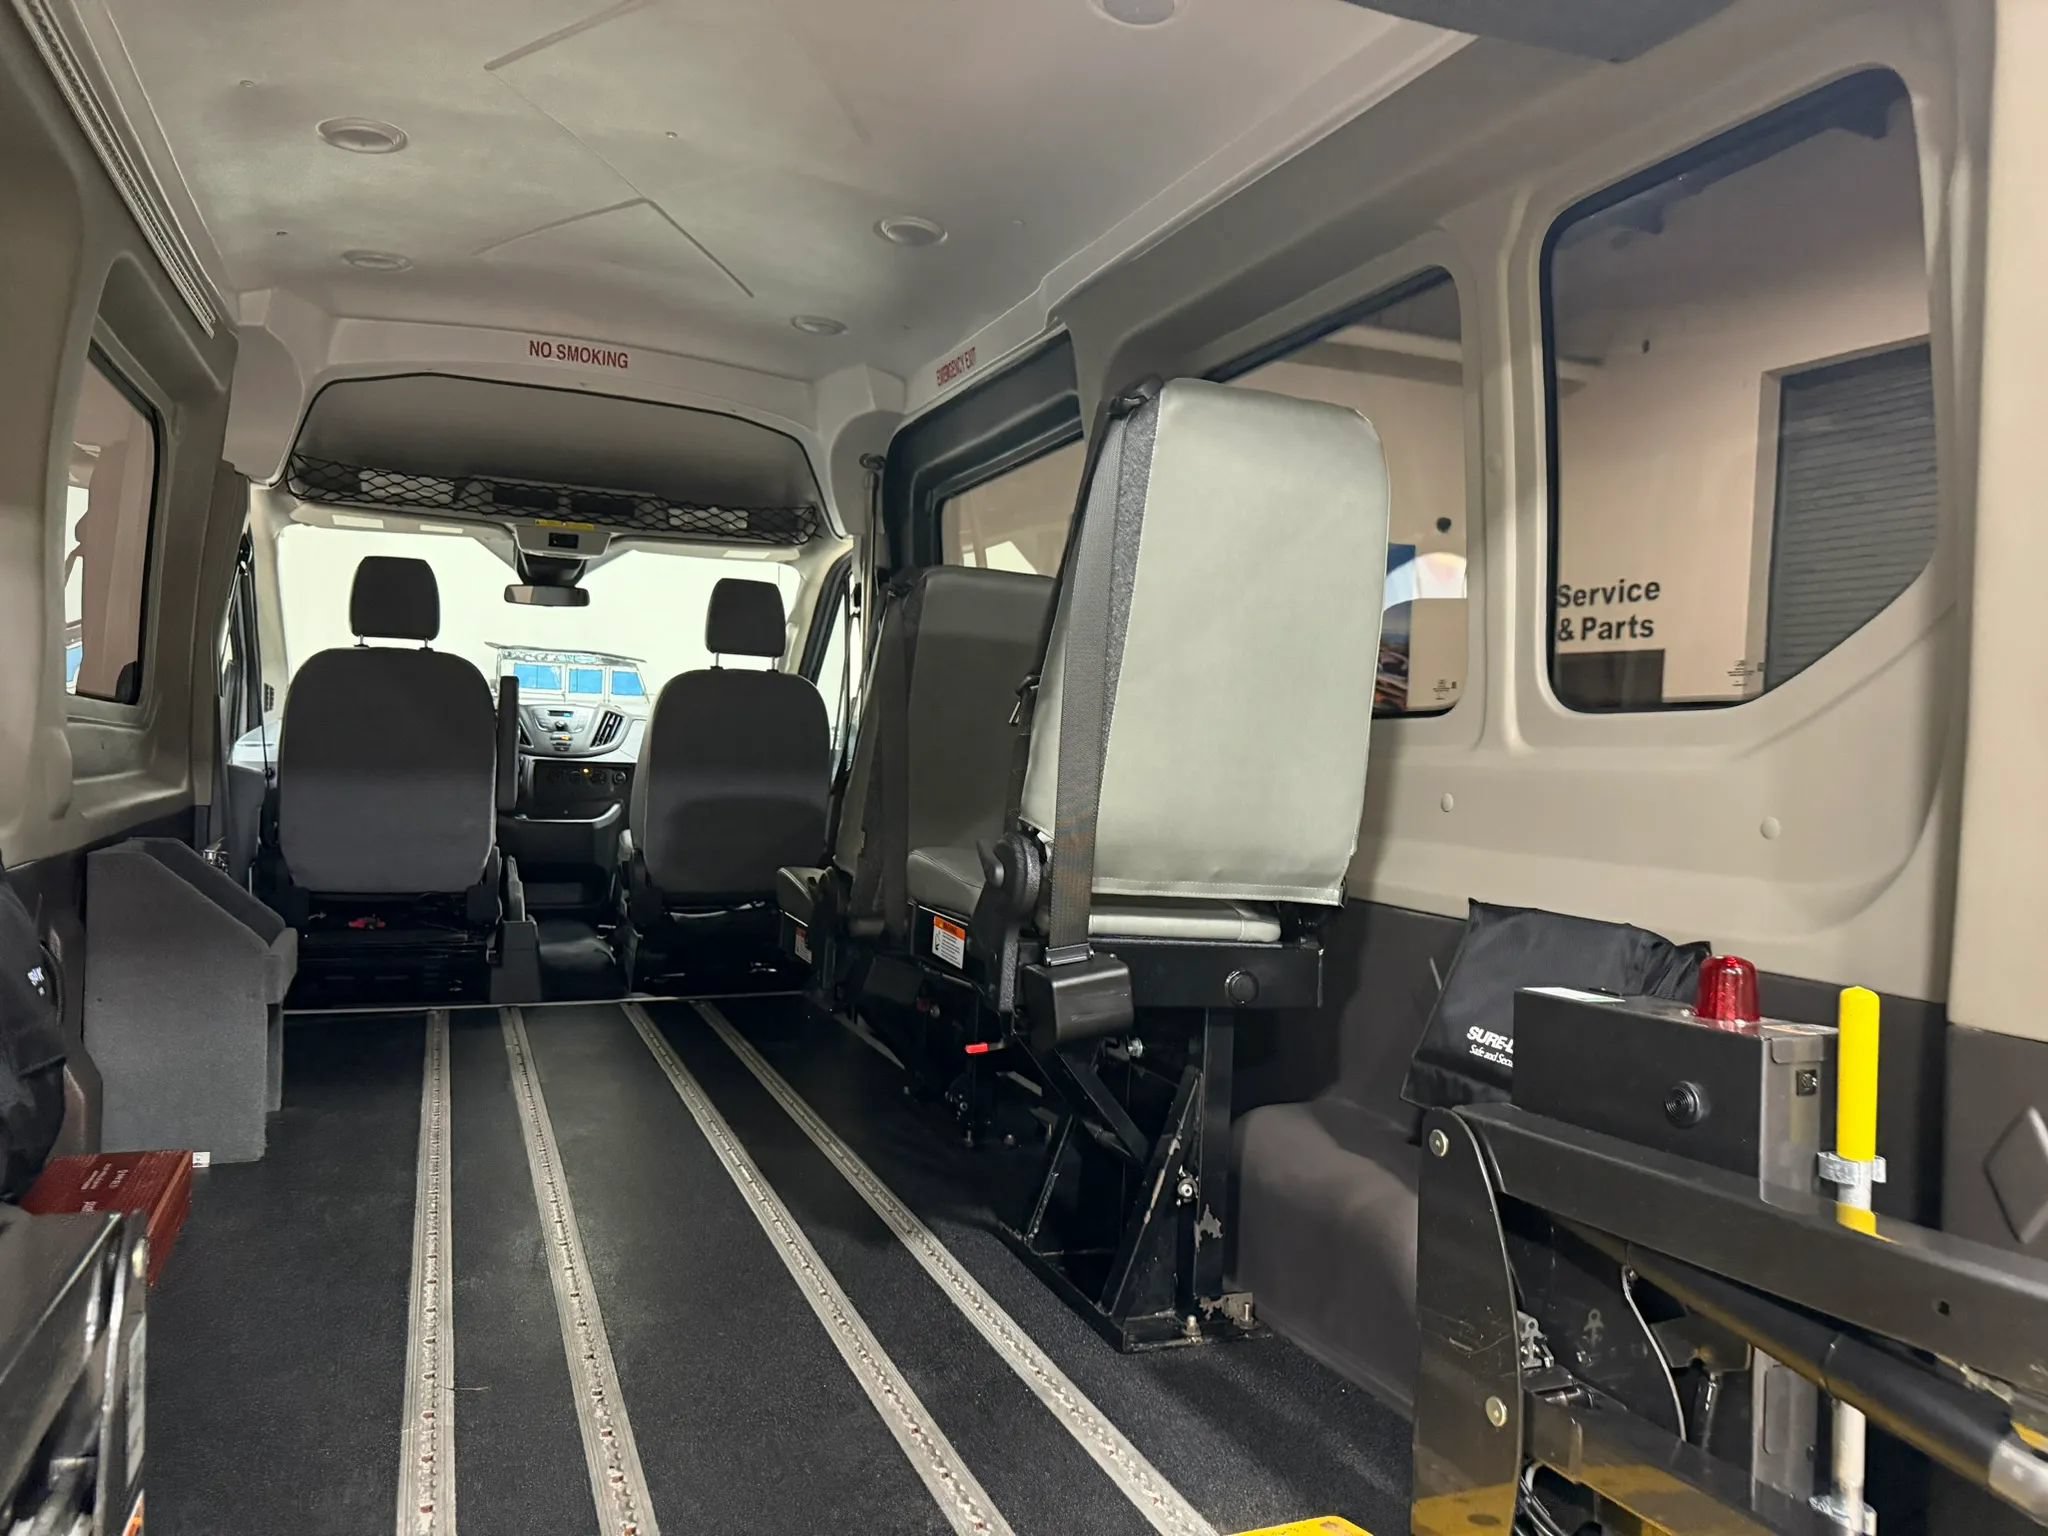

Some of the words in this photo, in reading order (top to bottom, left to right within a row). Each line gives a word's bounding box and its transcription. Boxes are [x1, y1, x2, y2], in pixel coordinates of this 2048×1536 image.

[529, 340, 552, 358] NO
[556, 343, 629, 369] SMOKING
[936, 355, 964, 386] EMERGENCY
[964, 346, 977, 369] EXIT
[1557, 579, 1660, 608] Service
[1558, 618, 1575, 642] &
[1581, 614, 1654, 641] Parts
[1469, 1044, 1485, 1057] Safe
[1484, 1051, 1499, 1062] and
